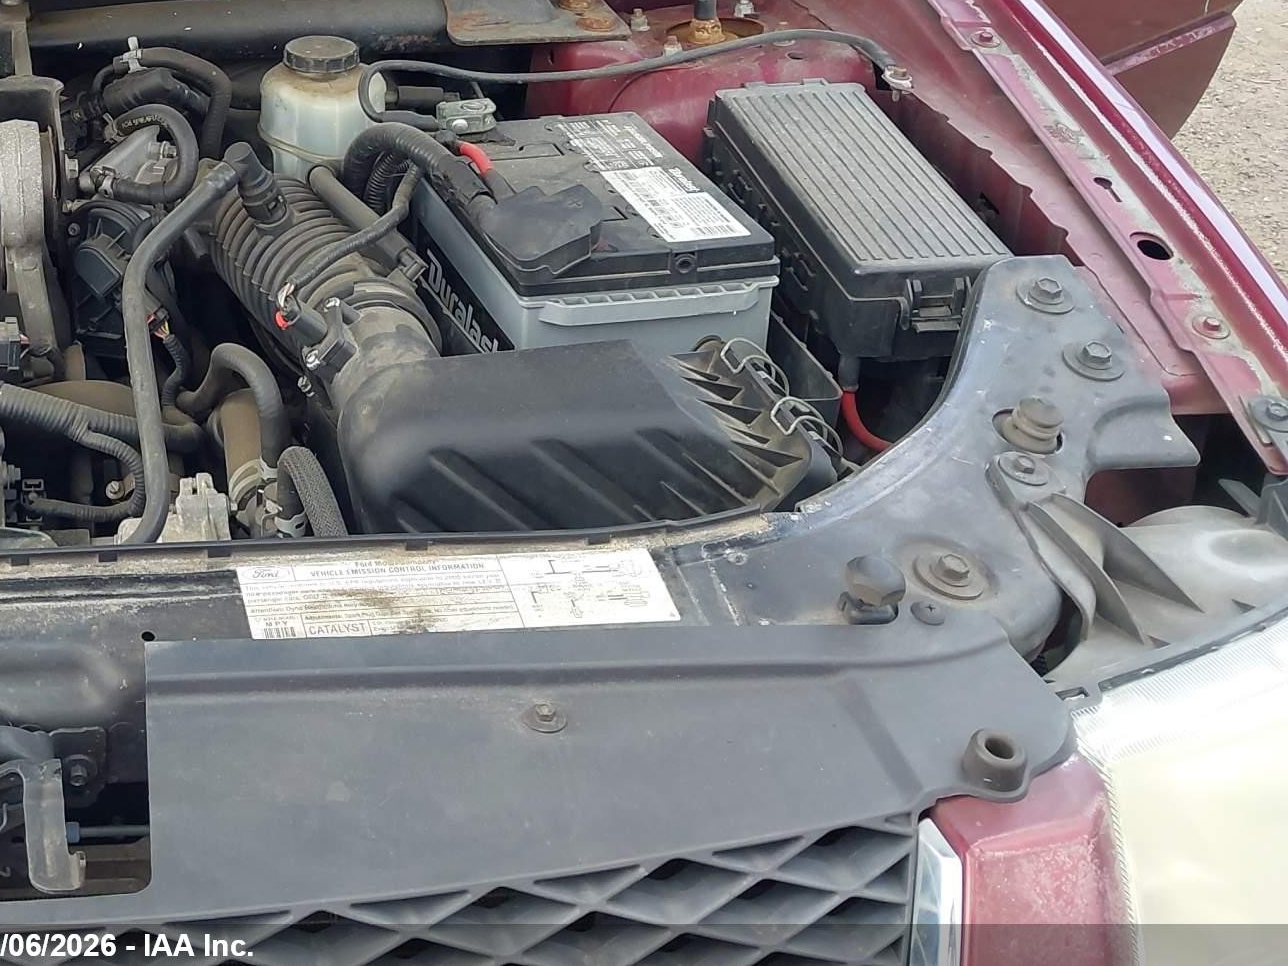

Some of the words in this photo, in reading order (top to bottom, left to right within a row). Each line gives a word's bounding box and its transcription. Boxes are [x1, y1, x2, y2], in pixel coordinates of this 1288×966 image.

[252, 568, 280, 579] Ford
[346, 568, 386, 576] EMISSION
[428, 562, 485, 572] INFORMATION
[308, 622, 366, 635] CATALYST
